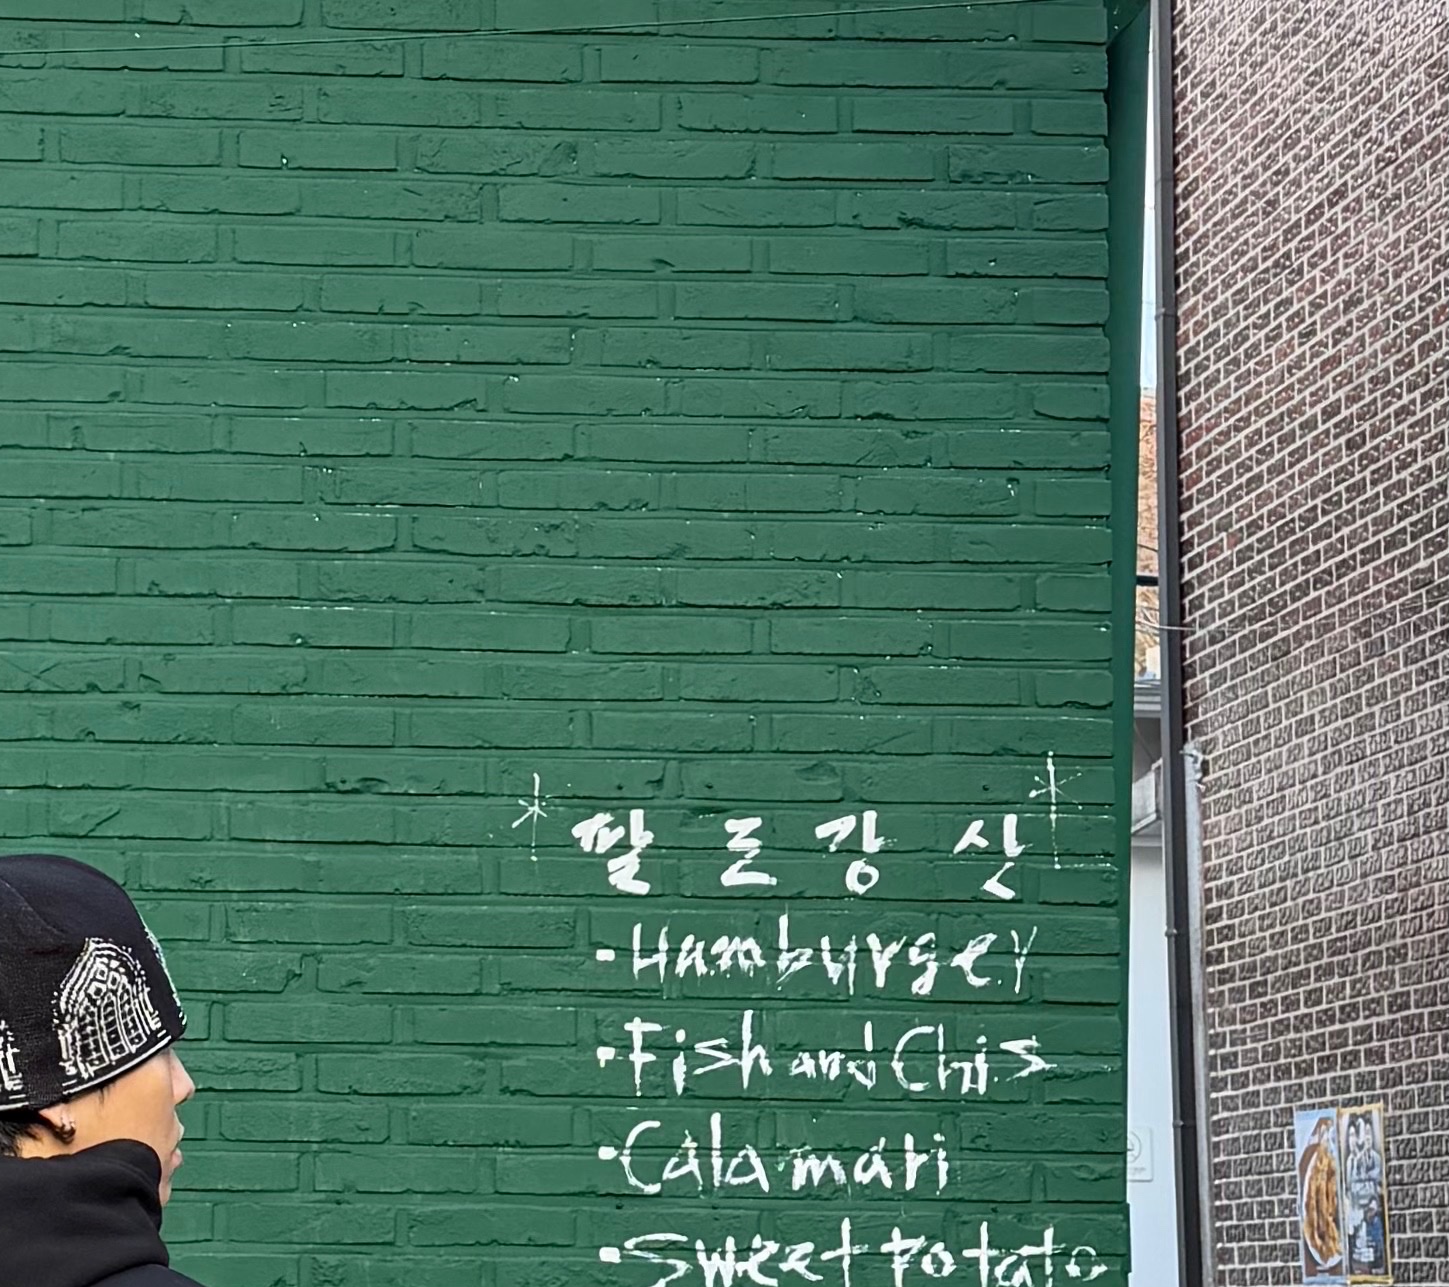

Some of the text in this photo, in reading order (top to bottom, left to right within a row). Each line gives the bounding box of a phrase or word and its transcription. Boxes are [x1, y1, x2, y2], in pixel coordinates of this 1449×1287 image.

[624, 1010, 773, 1096] Fish
[789, 1021, 876, 1090] and
[619, 1112, 950, 1194] Calamari
